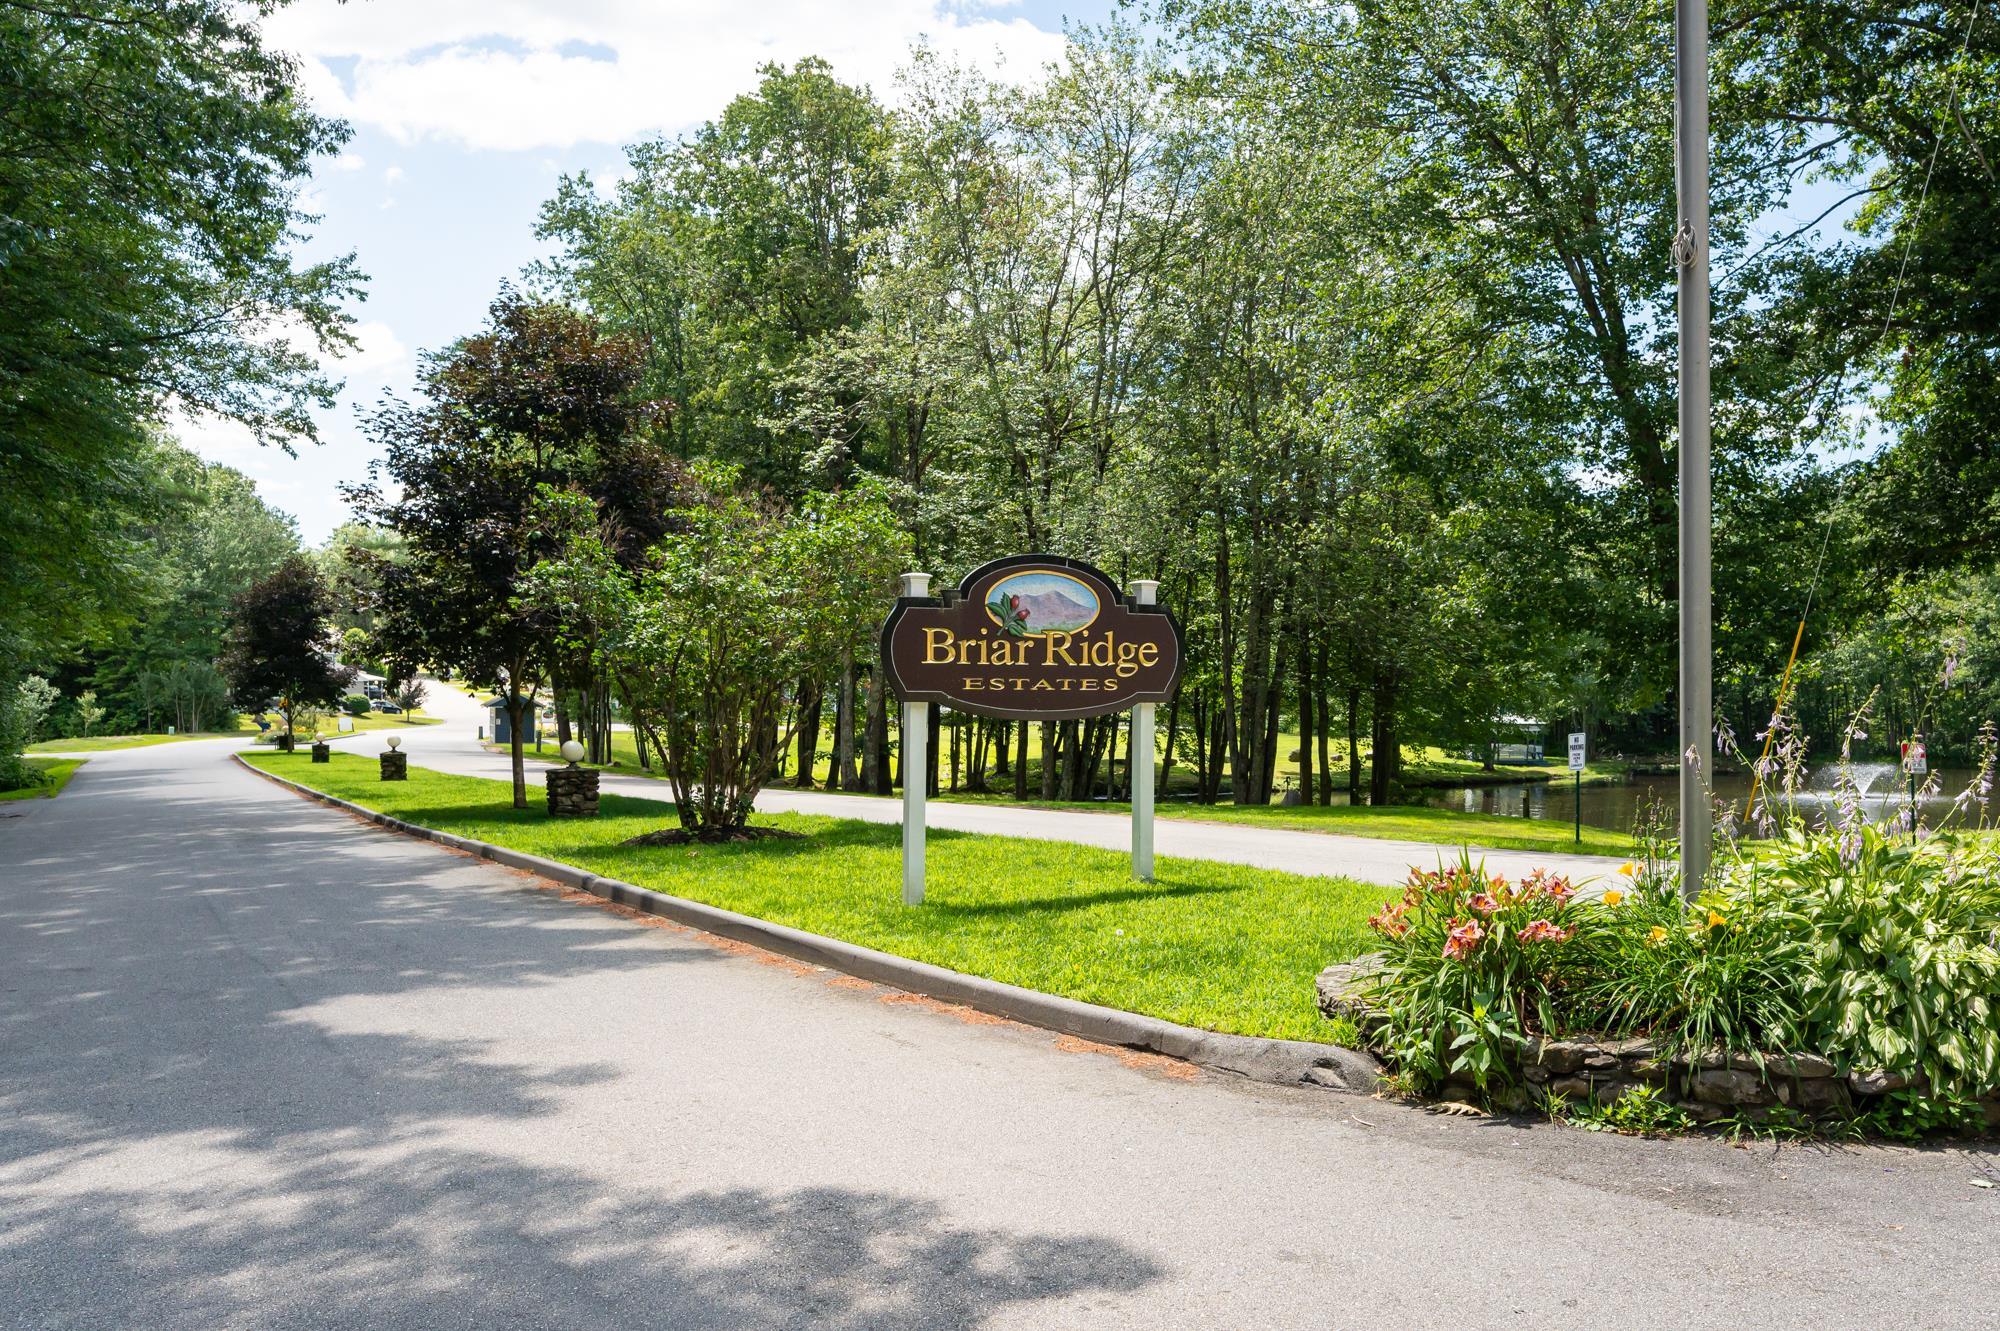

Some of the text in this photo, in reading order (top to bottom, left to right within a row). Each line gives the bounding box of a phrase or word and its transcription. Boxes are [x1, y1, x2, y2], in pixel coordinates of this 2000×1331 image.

[921, 627, 1159, 678] Briar Ridge
[962, 677, 1119, 691] ESTATES
